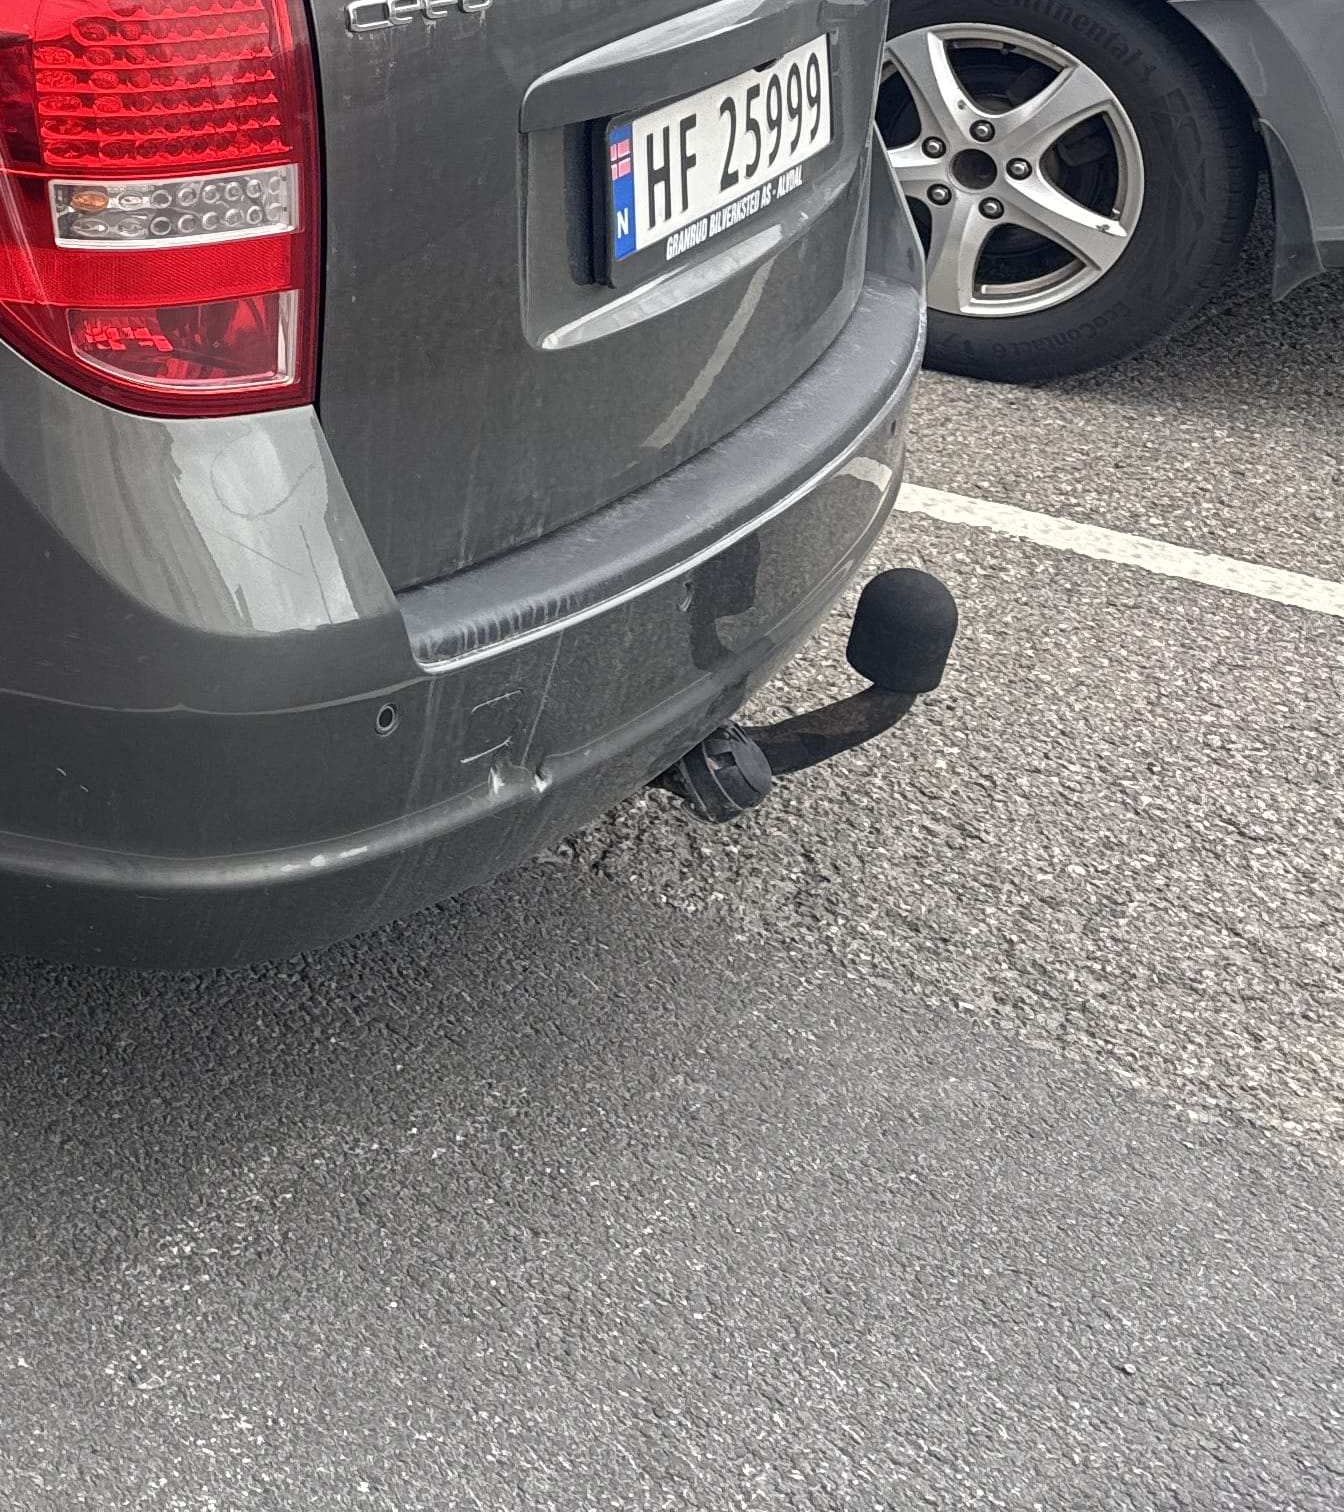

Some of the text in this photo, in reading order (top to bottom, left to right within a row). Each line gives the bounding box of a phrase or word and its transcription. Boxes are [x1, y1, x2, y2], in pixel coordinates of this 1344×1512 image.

[616, 51, 822, 239] N HF 25999
[665, 217, 708, 261] GRANRUD
[708, 189, 761, 238] BILVERKSTED
[760, 182, 772, 209] AS
